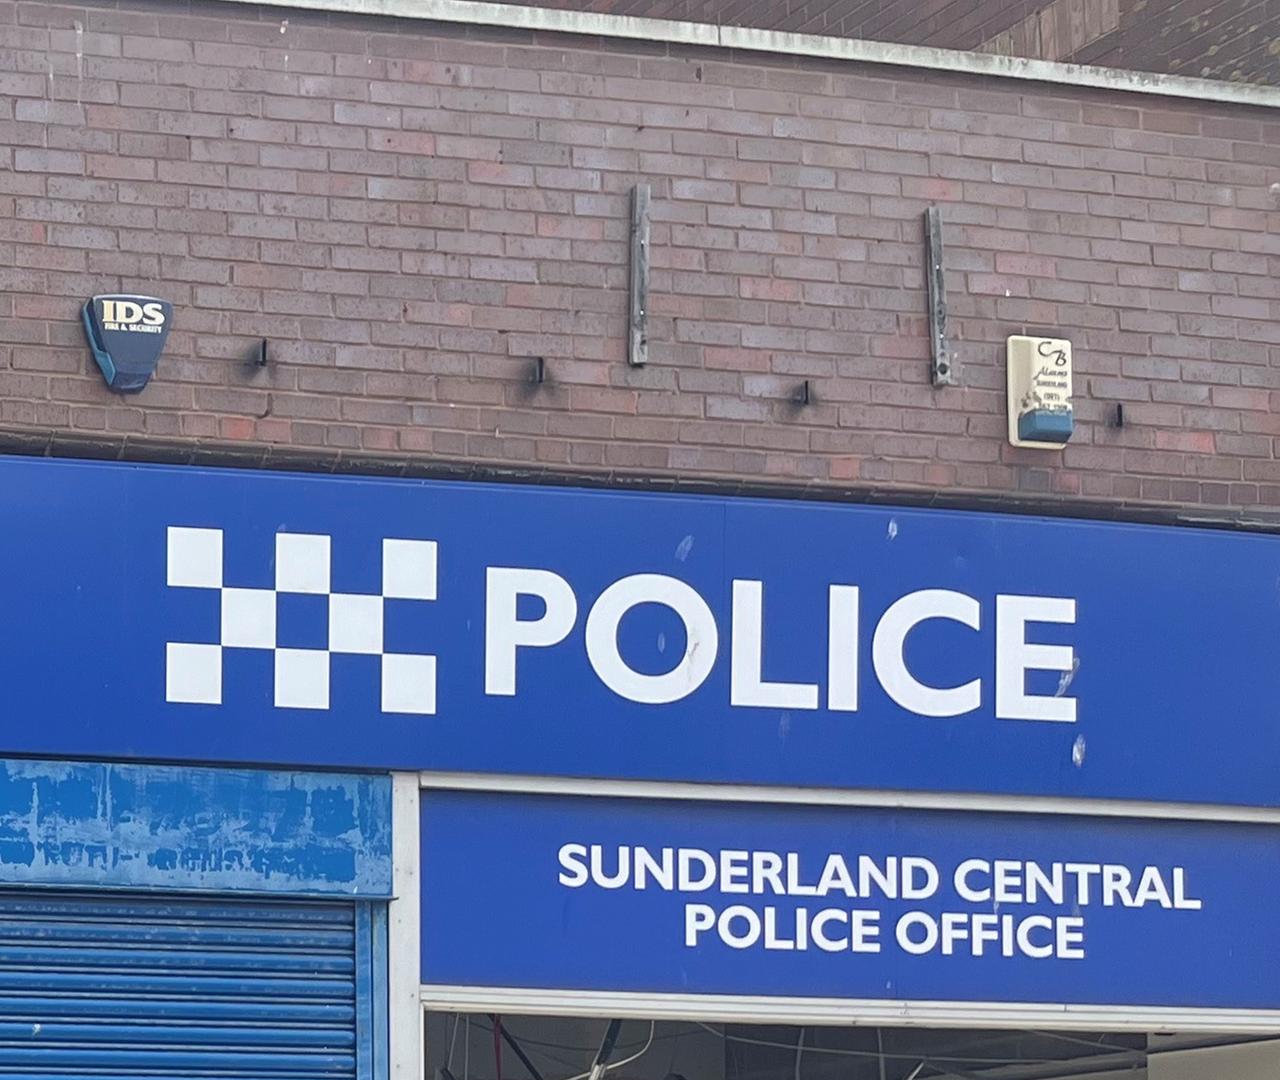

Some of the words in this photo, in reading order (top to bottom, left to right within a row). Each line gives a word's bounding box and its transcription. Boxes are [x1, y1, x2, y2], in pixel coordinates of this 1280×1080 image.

[102, 300, 165, 325] IDS
[484, 565, 1077, 722] POLICE
[557, 843, 940, 899] SUNDERLAND
[953, 858, 1203, 910] CENTRAL
[684, 903, 881, 953] POLICE
[895, 910, 1085, 959] OFFICE
